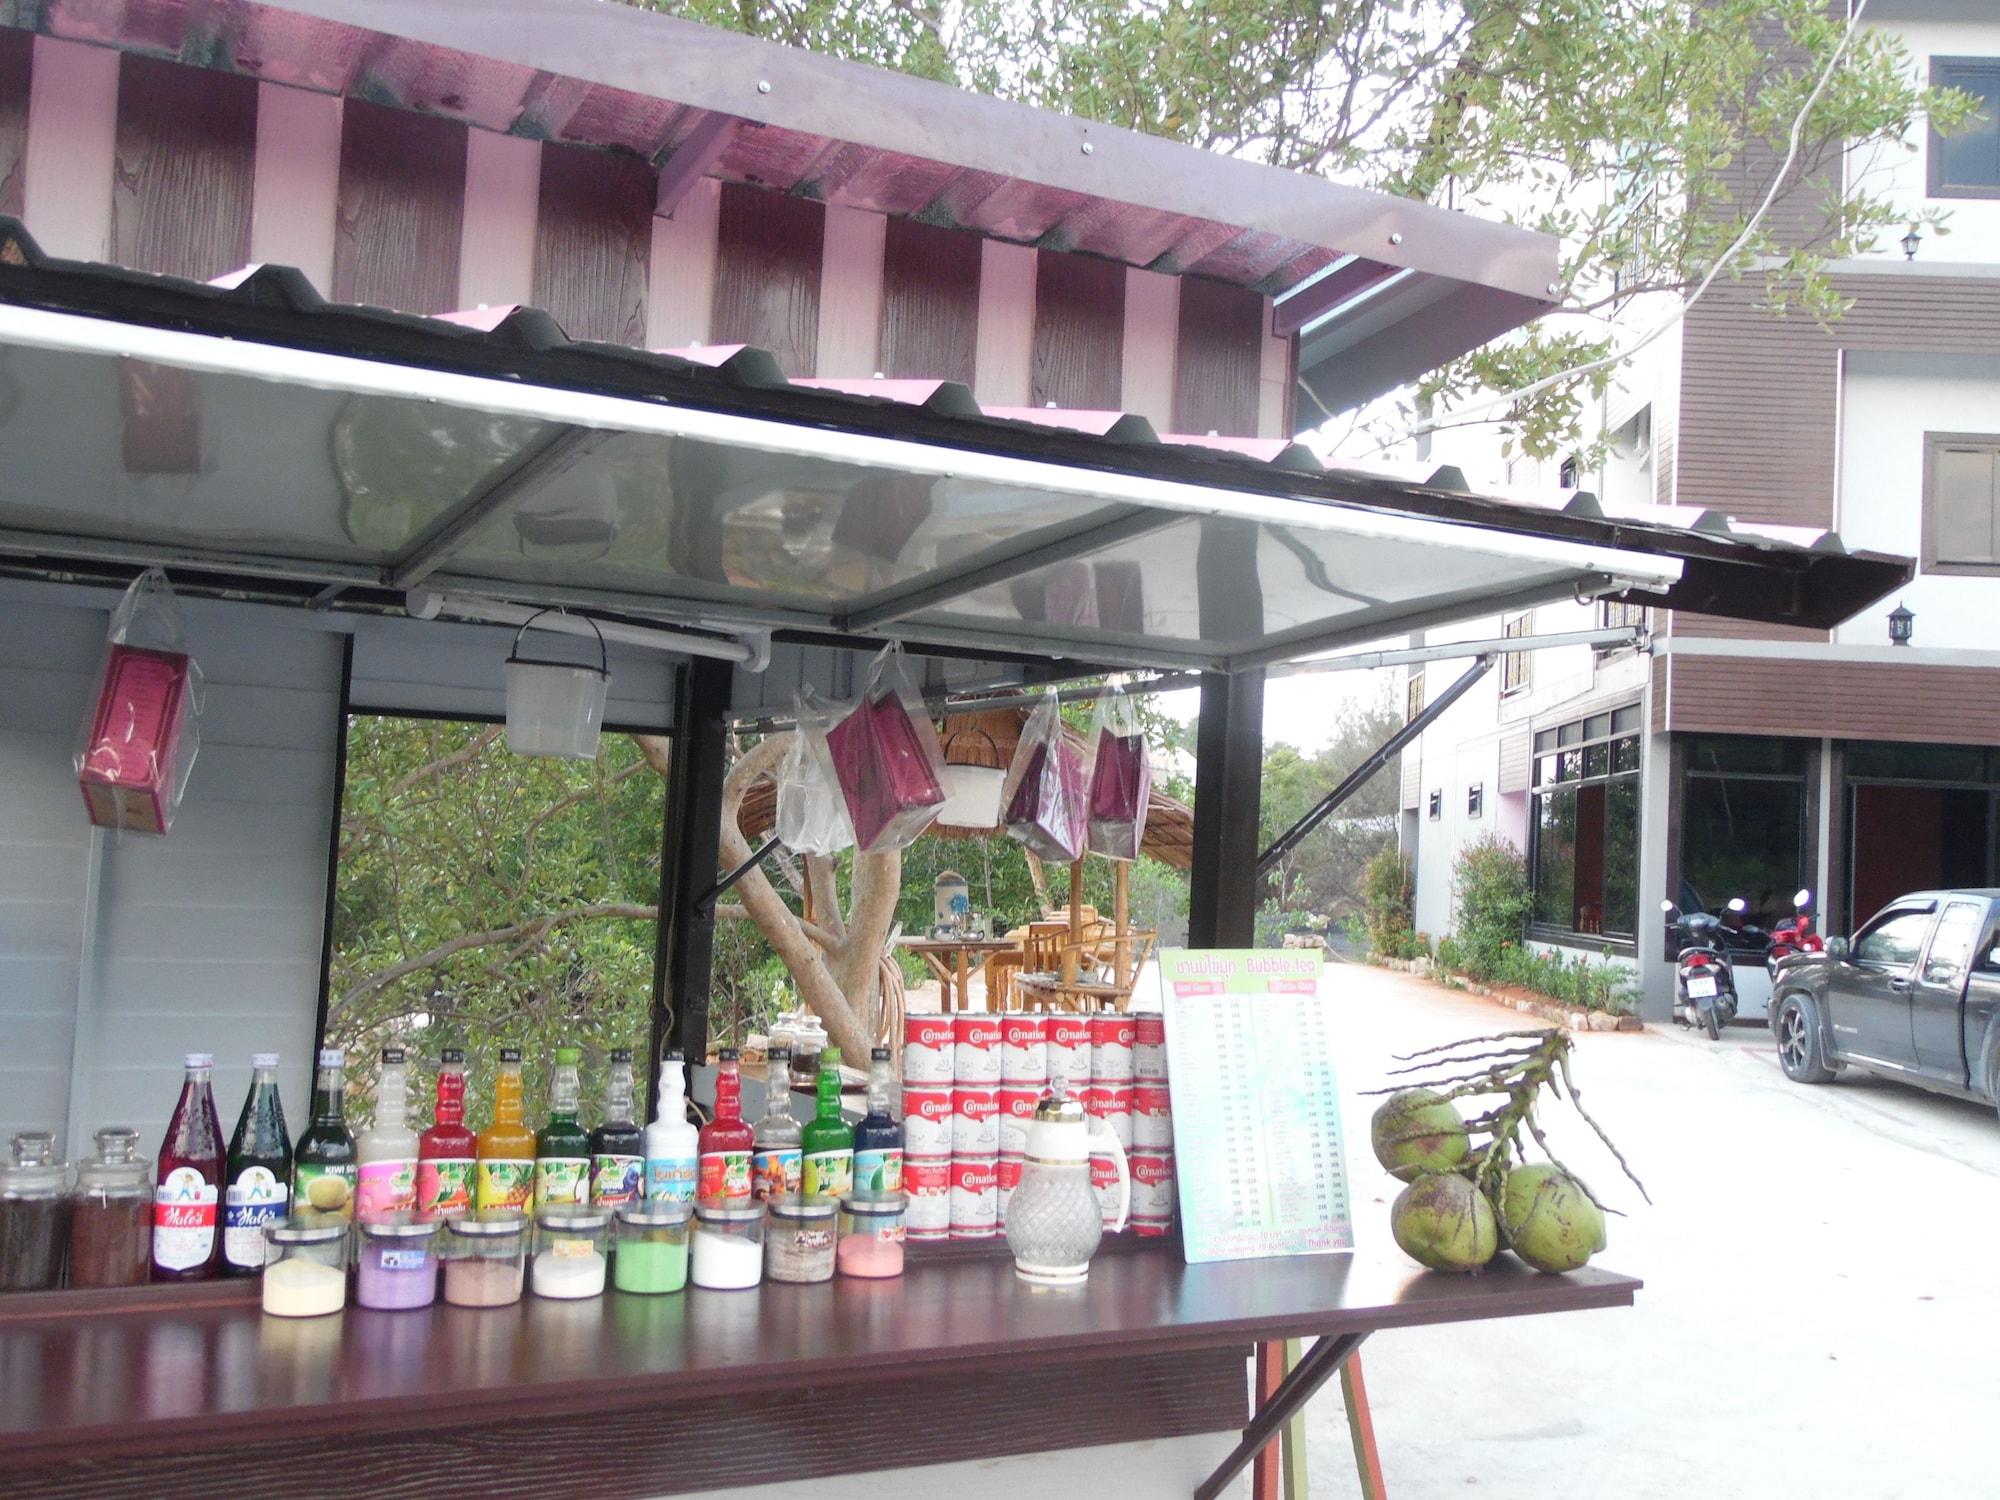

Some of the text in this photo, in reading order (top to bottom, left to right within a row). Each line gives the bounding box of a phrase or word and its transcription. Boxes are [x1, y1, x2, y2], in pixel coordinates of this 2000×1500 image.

[1176, 955, 1236, 977] ชานมไข่มุก
[1247, 956, 1316, 974] Bubble tea
